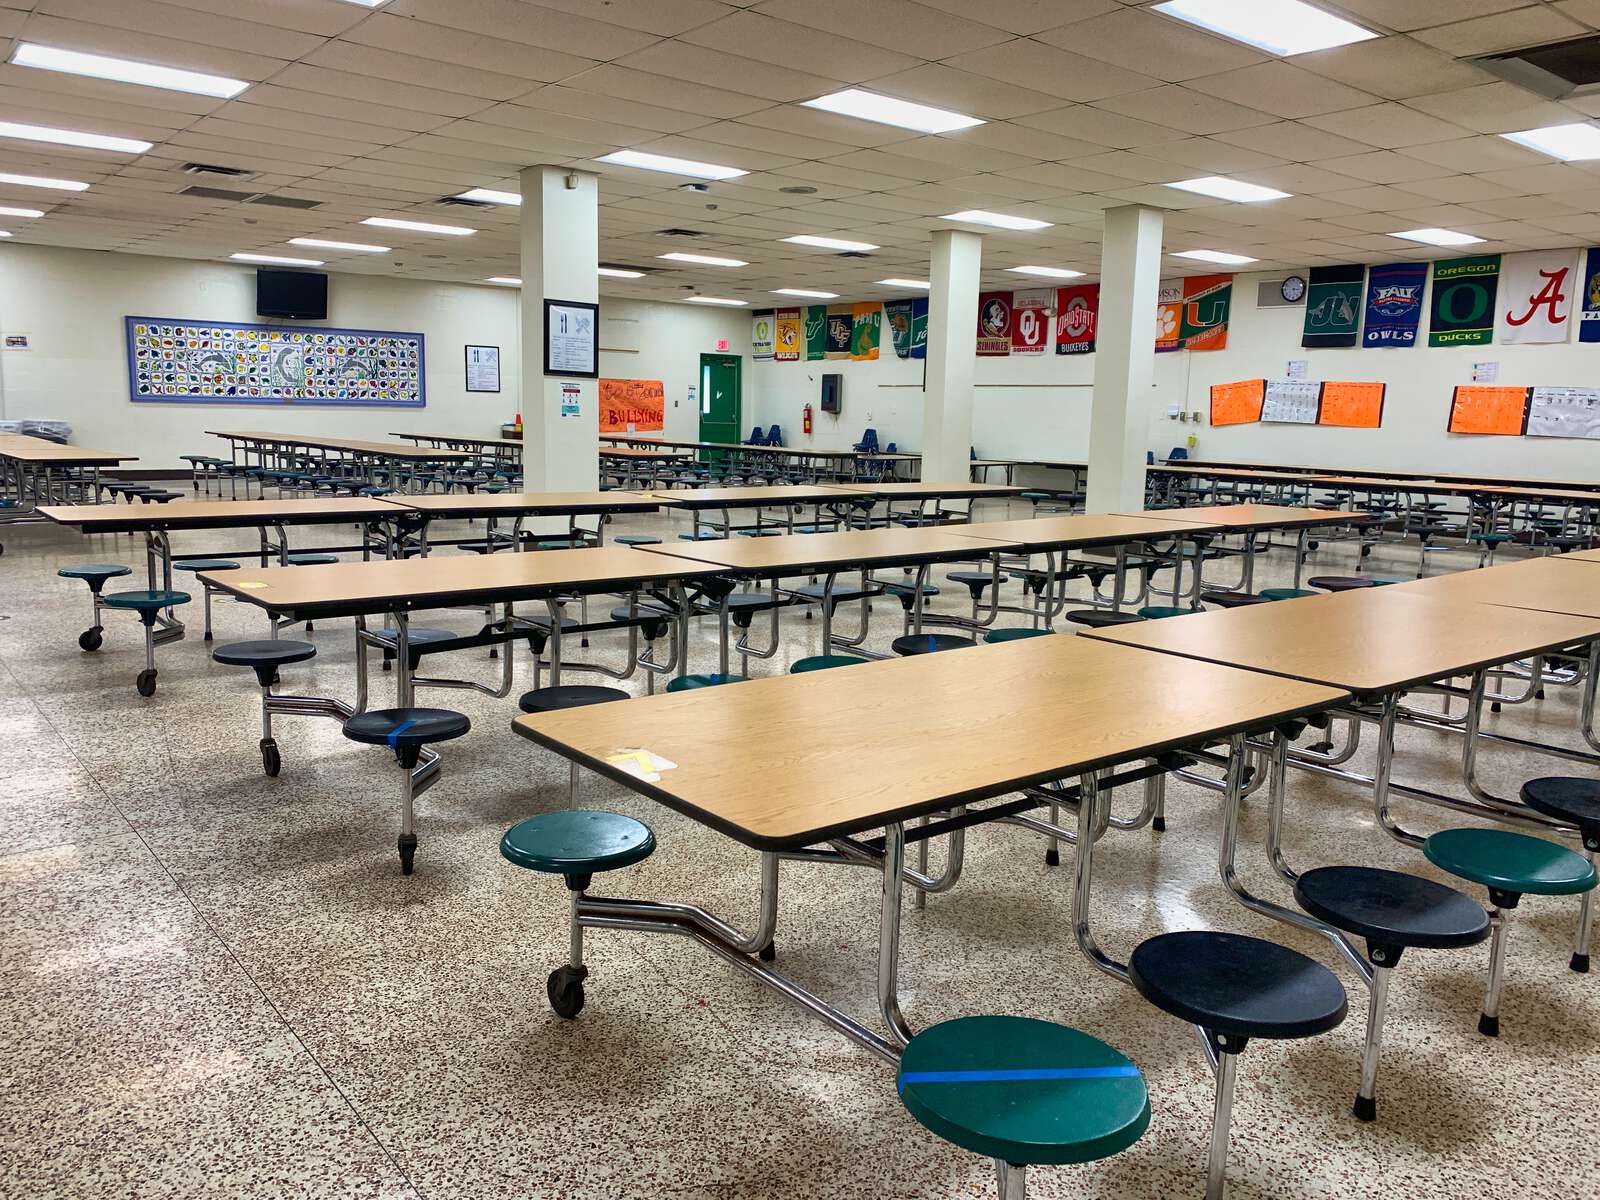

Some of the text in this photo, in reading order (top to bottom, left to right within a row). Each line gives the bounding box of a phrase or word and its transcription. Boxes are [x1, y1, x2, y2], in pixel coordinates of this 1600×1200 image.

[1437, 264, 1496, 276] OREGON
[1377, 287, 1415, 299] FAU
[1506, 267, 1569, 326] A
[1368, 330, 1414, 340] OWLS
[1438, 332, 1481, 342] DUCKS
[1061, 342, 1089, 352] BUCKEYES
[608, 408, 663, 425] BULLYING
